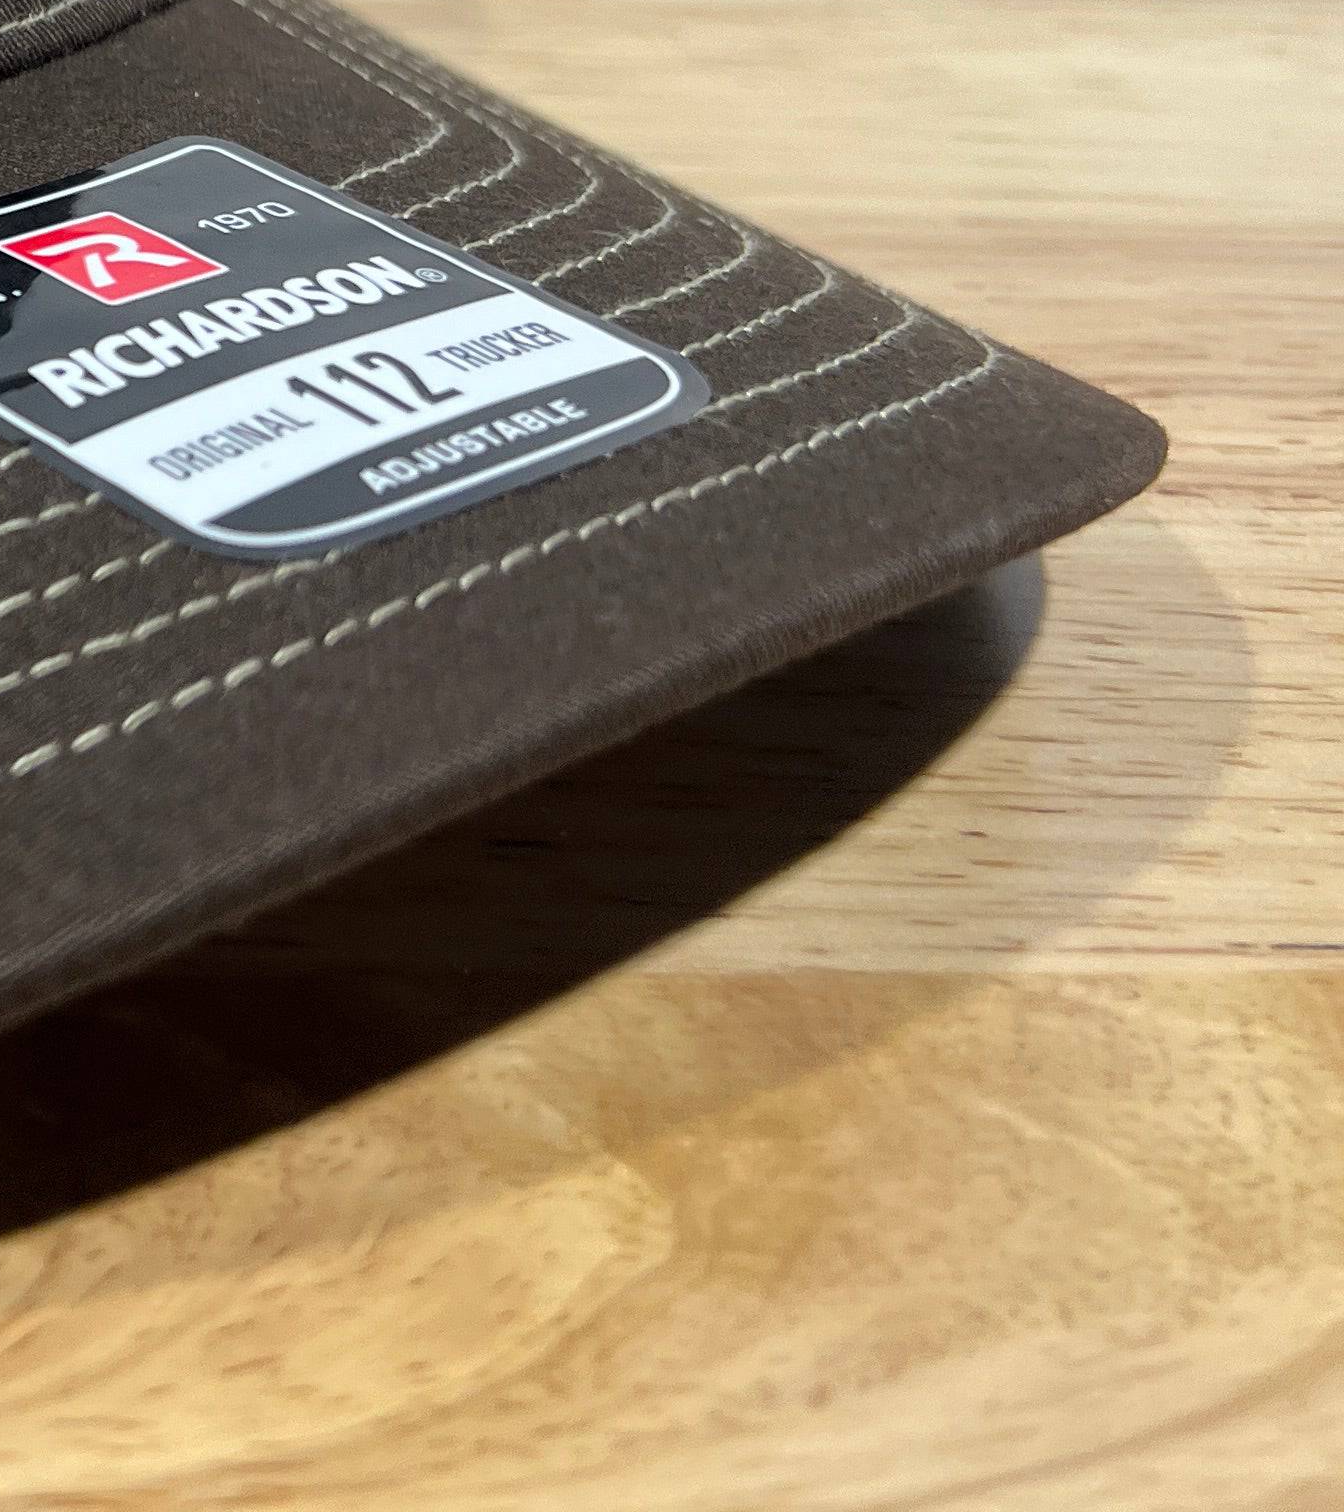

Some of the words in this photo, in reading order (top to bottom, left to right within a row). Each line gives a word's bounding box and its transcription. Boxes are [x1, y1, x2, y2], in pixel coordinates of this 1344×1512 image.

[195, 199, 298, 238] 1970
[146, 403, 315, 482] ORIGINAL
[286, 348, 462, 429] 112
[424, 318, 573, 377] TRUCKER
[357, 395, 589, 496] ADJUSTABLE
